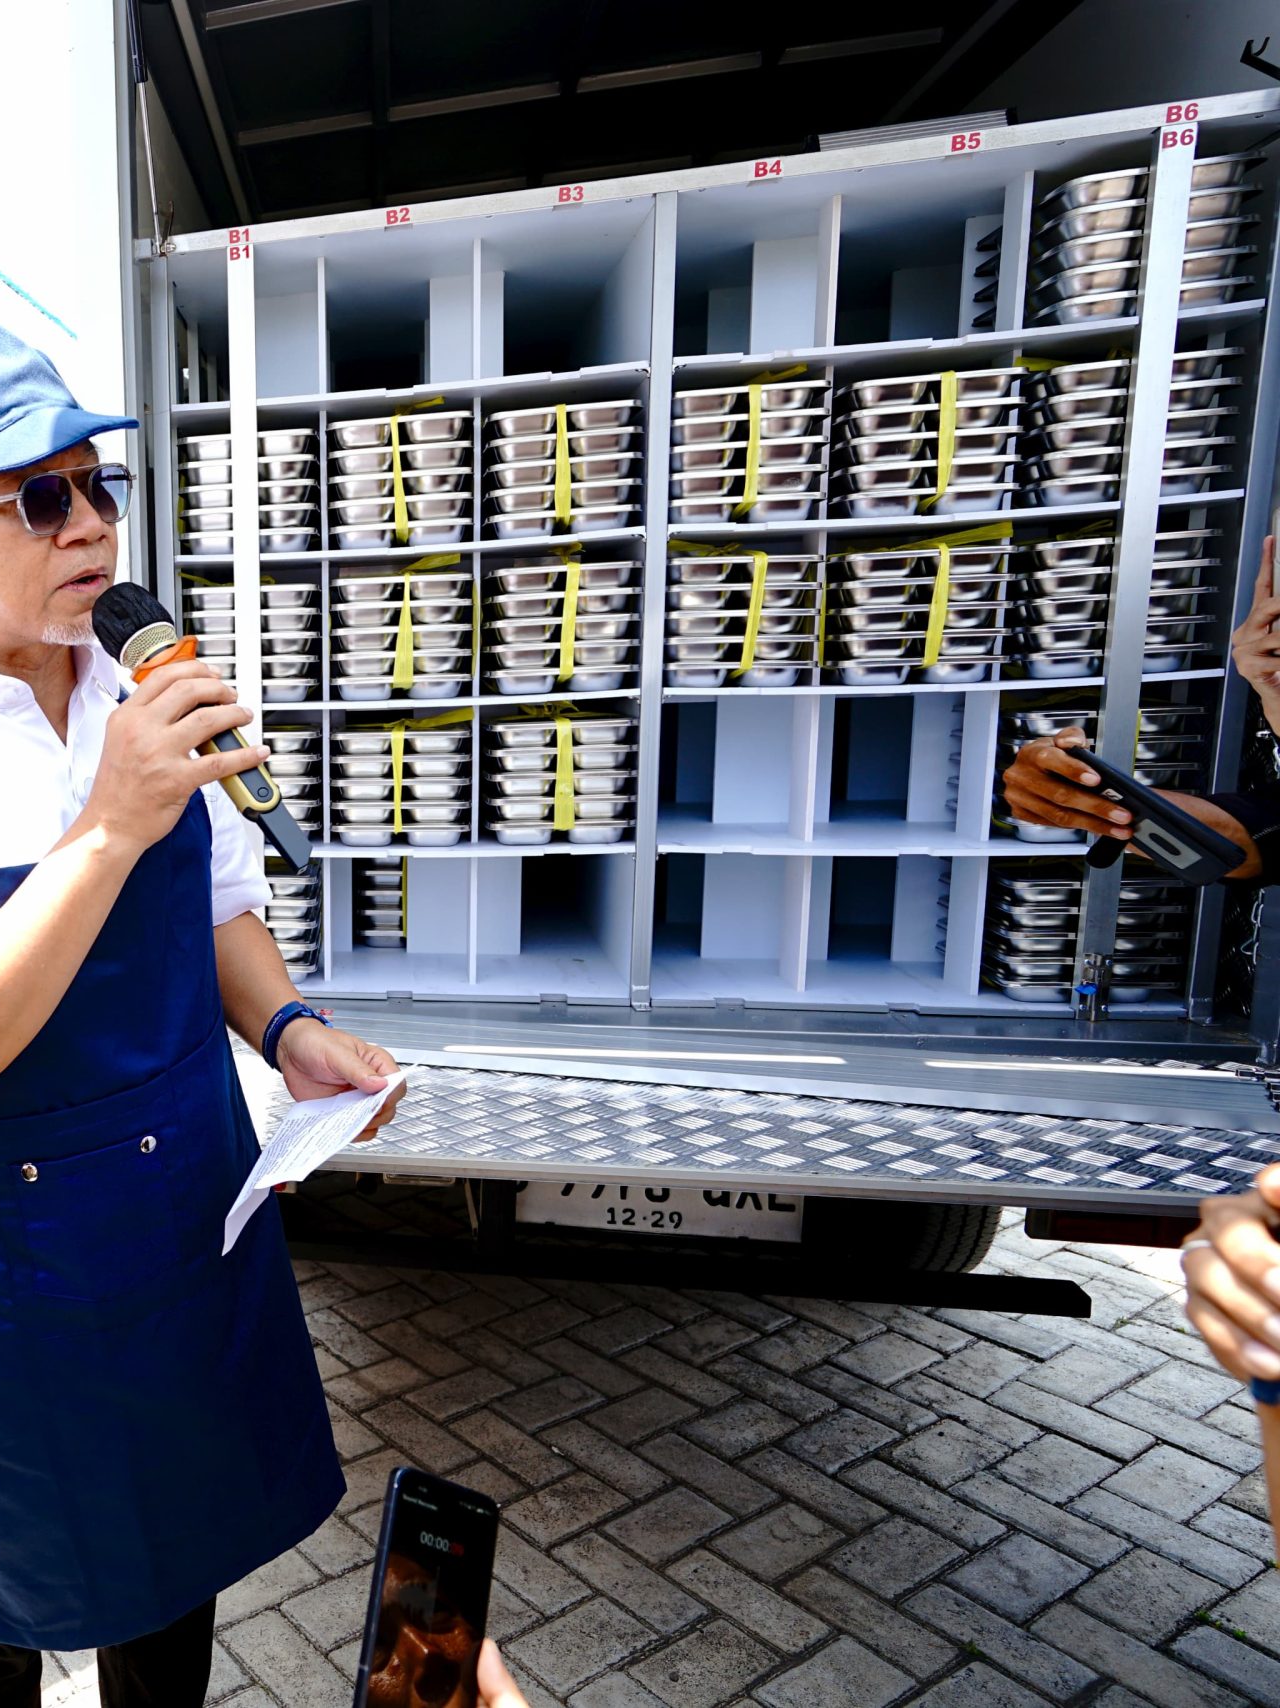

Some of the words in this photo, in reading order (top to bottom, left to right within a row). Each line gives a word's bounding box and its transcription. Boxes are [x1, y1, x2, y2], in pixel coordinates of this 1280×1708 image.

[1165, 102, 1199, 124] B6
[950, 132, 981, 153] B5
[1162, 128, 1194, 149] B6
[753, 159, 783, 179] B4
[558, 185, 584, 203] B3
[385, 207, 411, 225] B2
[228, 227, 250, 244] B1
[229, 244, 250, 261] B1
